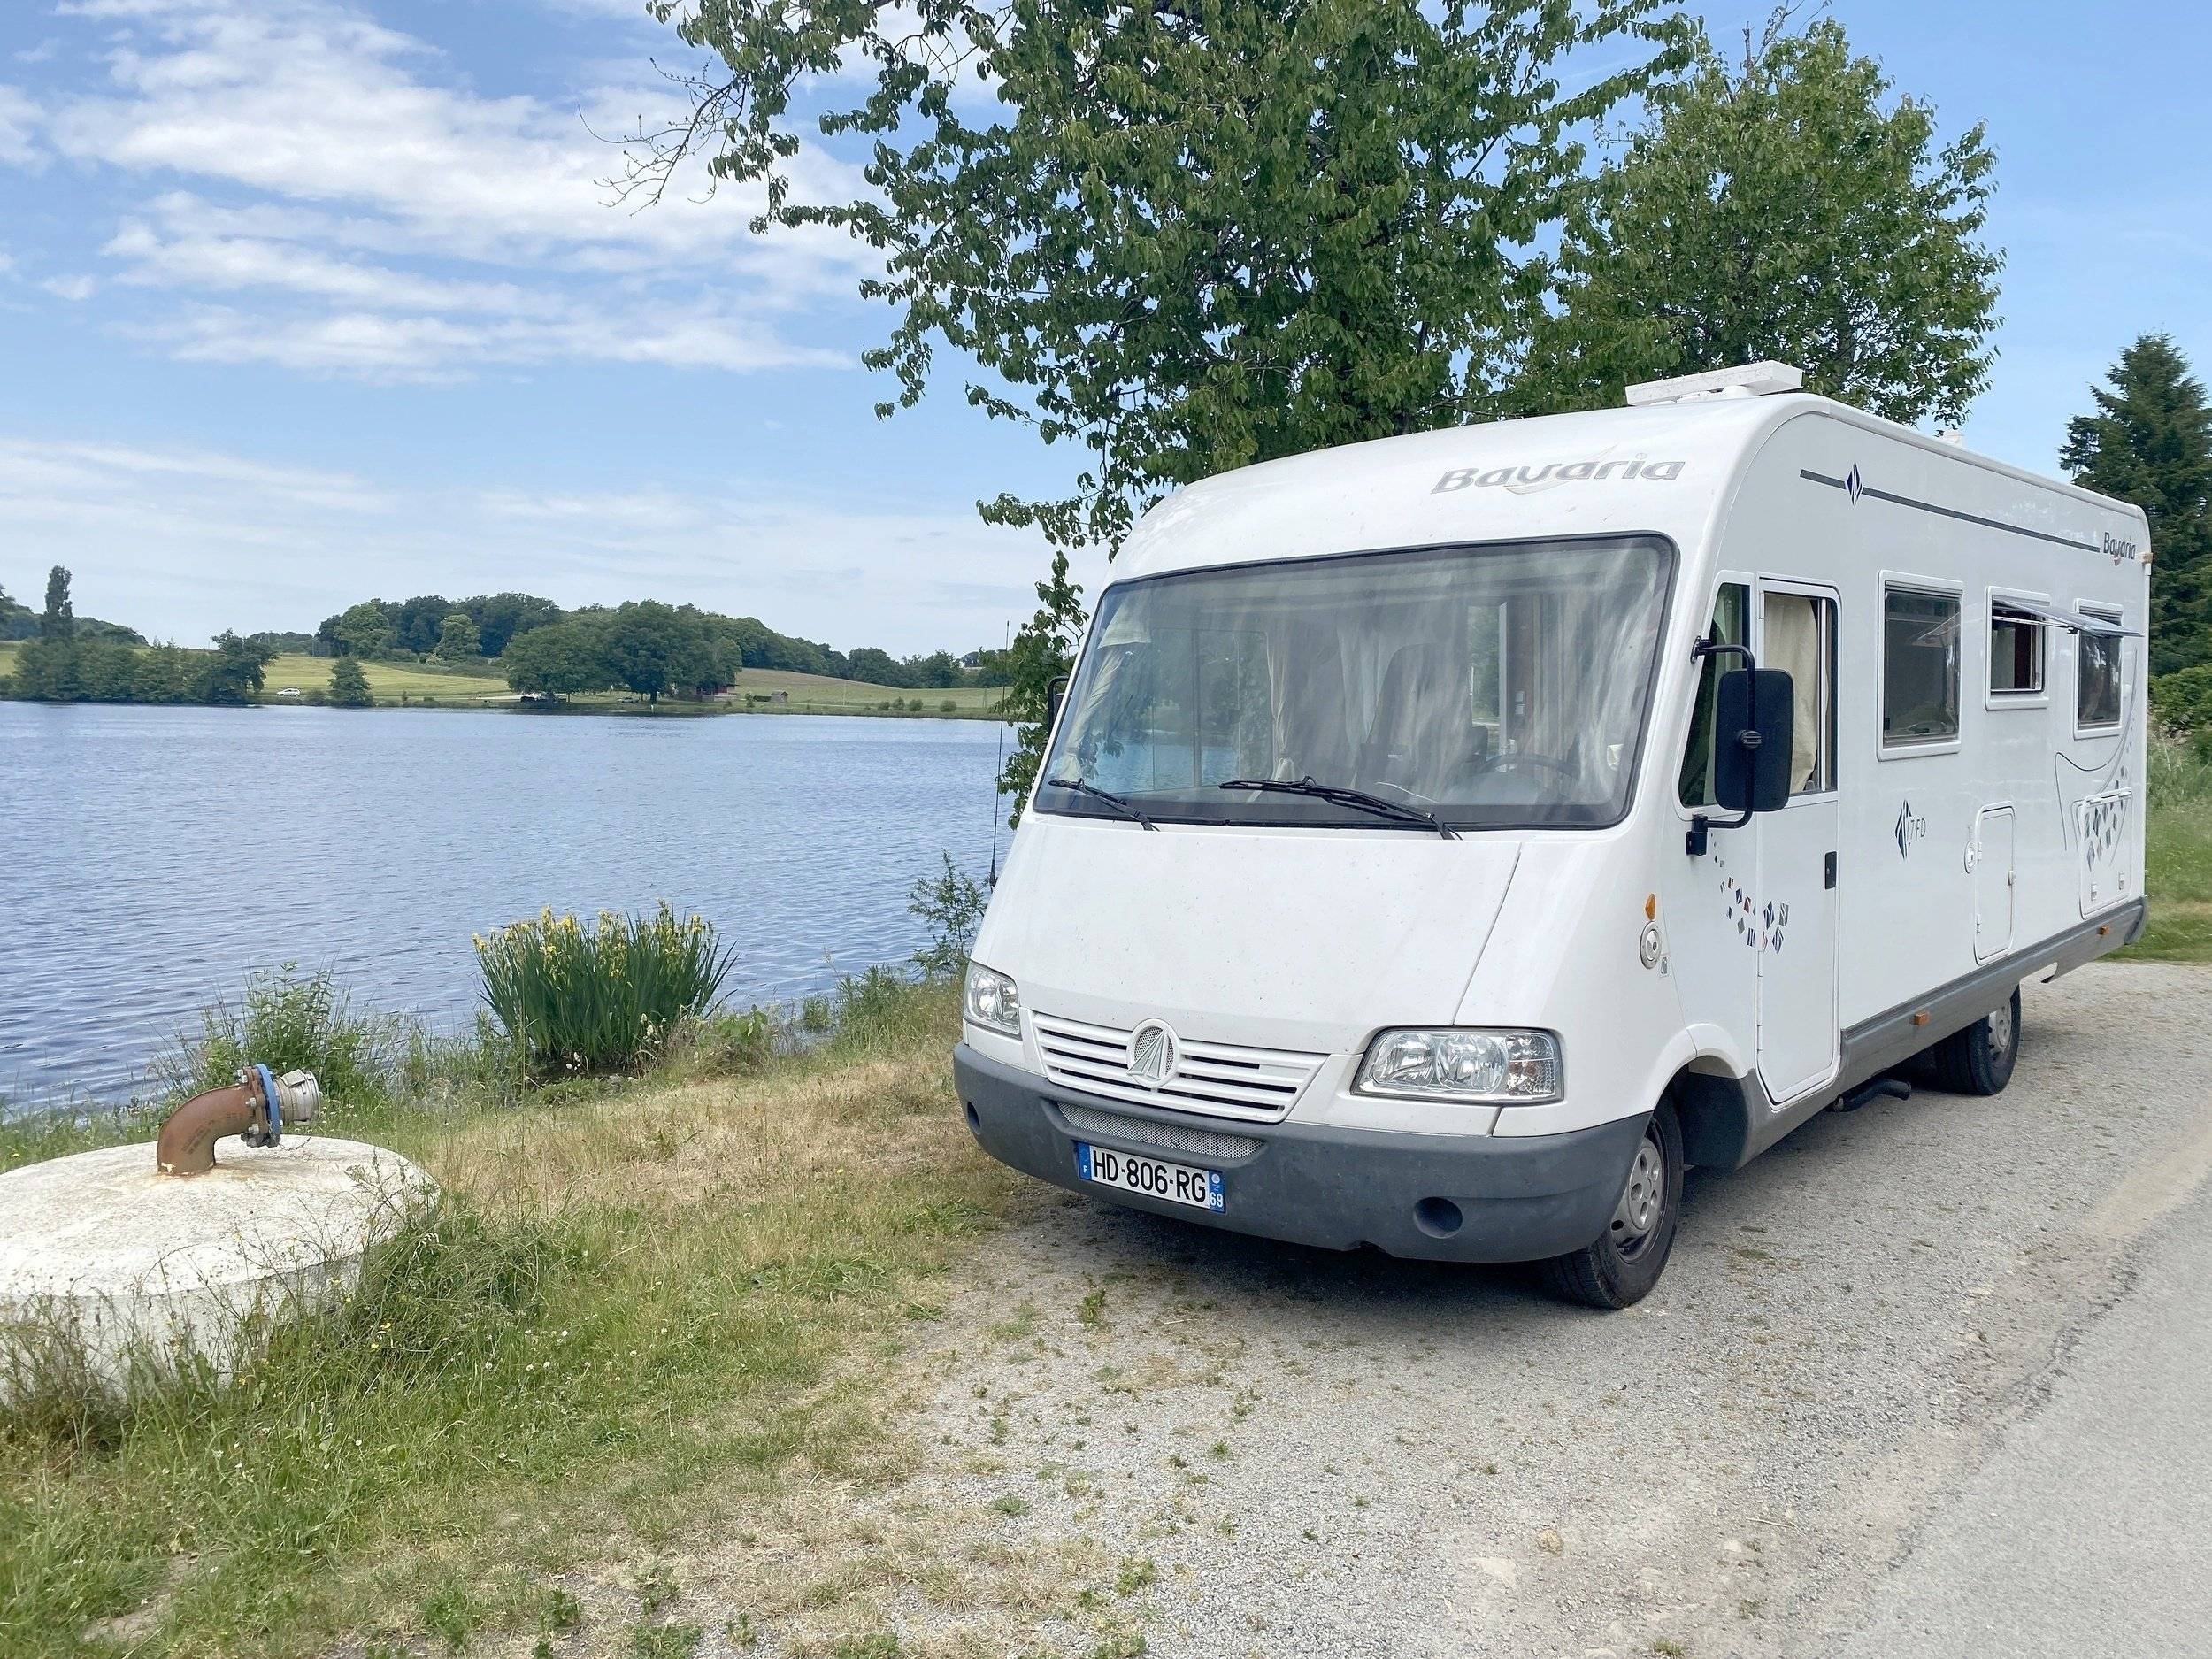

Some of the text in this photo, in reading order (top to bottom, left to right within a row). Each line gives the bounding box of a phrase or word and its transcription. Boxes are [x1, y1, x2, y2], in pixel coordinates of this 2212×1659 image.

[1431, 452, 1686, 495] Bavaria
[2103, 531, 2137, 560] Bavaria
[1209, 1191, 1225, 1209] 69
